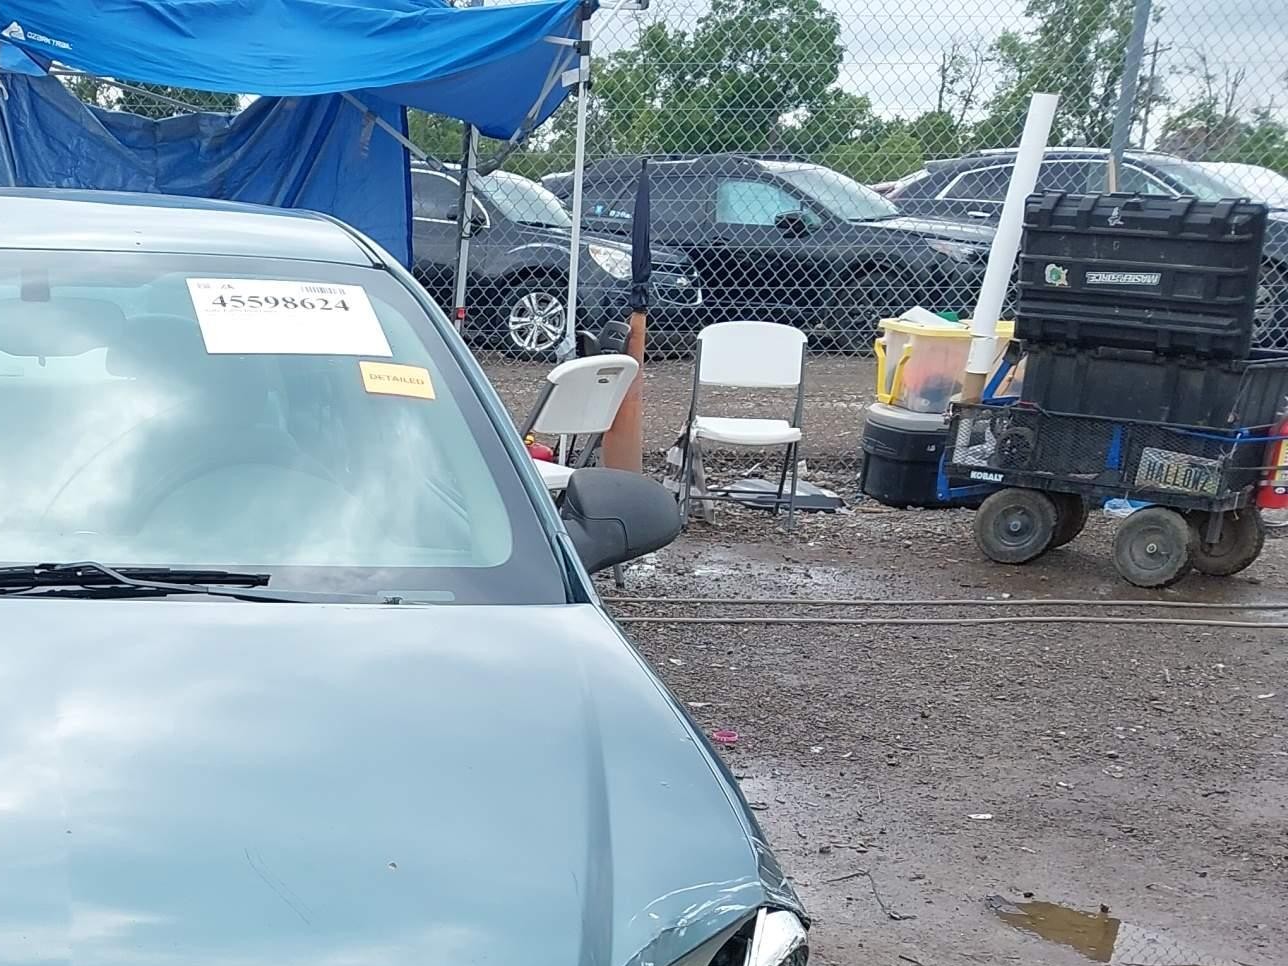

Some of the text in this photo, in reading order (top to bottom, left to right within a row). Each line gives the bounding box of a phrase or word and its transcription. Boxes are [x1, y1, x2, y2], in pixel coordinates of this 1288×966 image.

[211, 294, 350, 312] 45598624
[368, 373, 425, 385] DETAILED
[970, 470, 1005, 482] KOBALT
